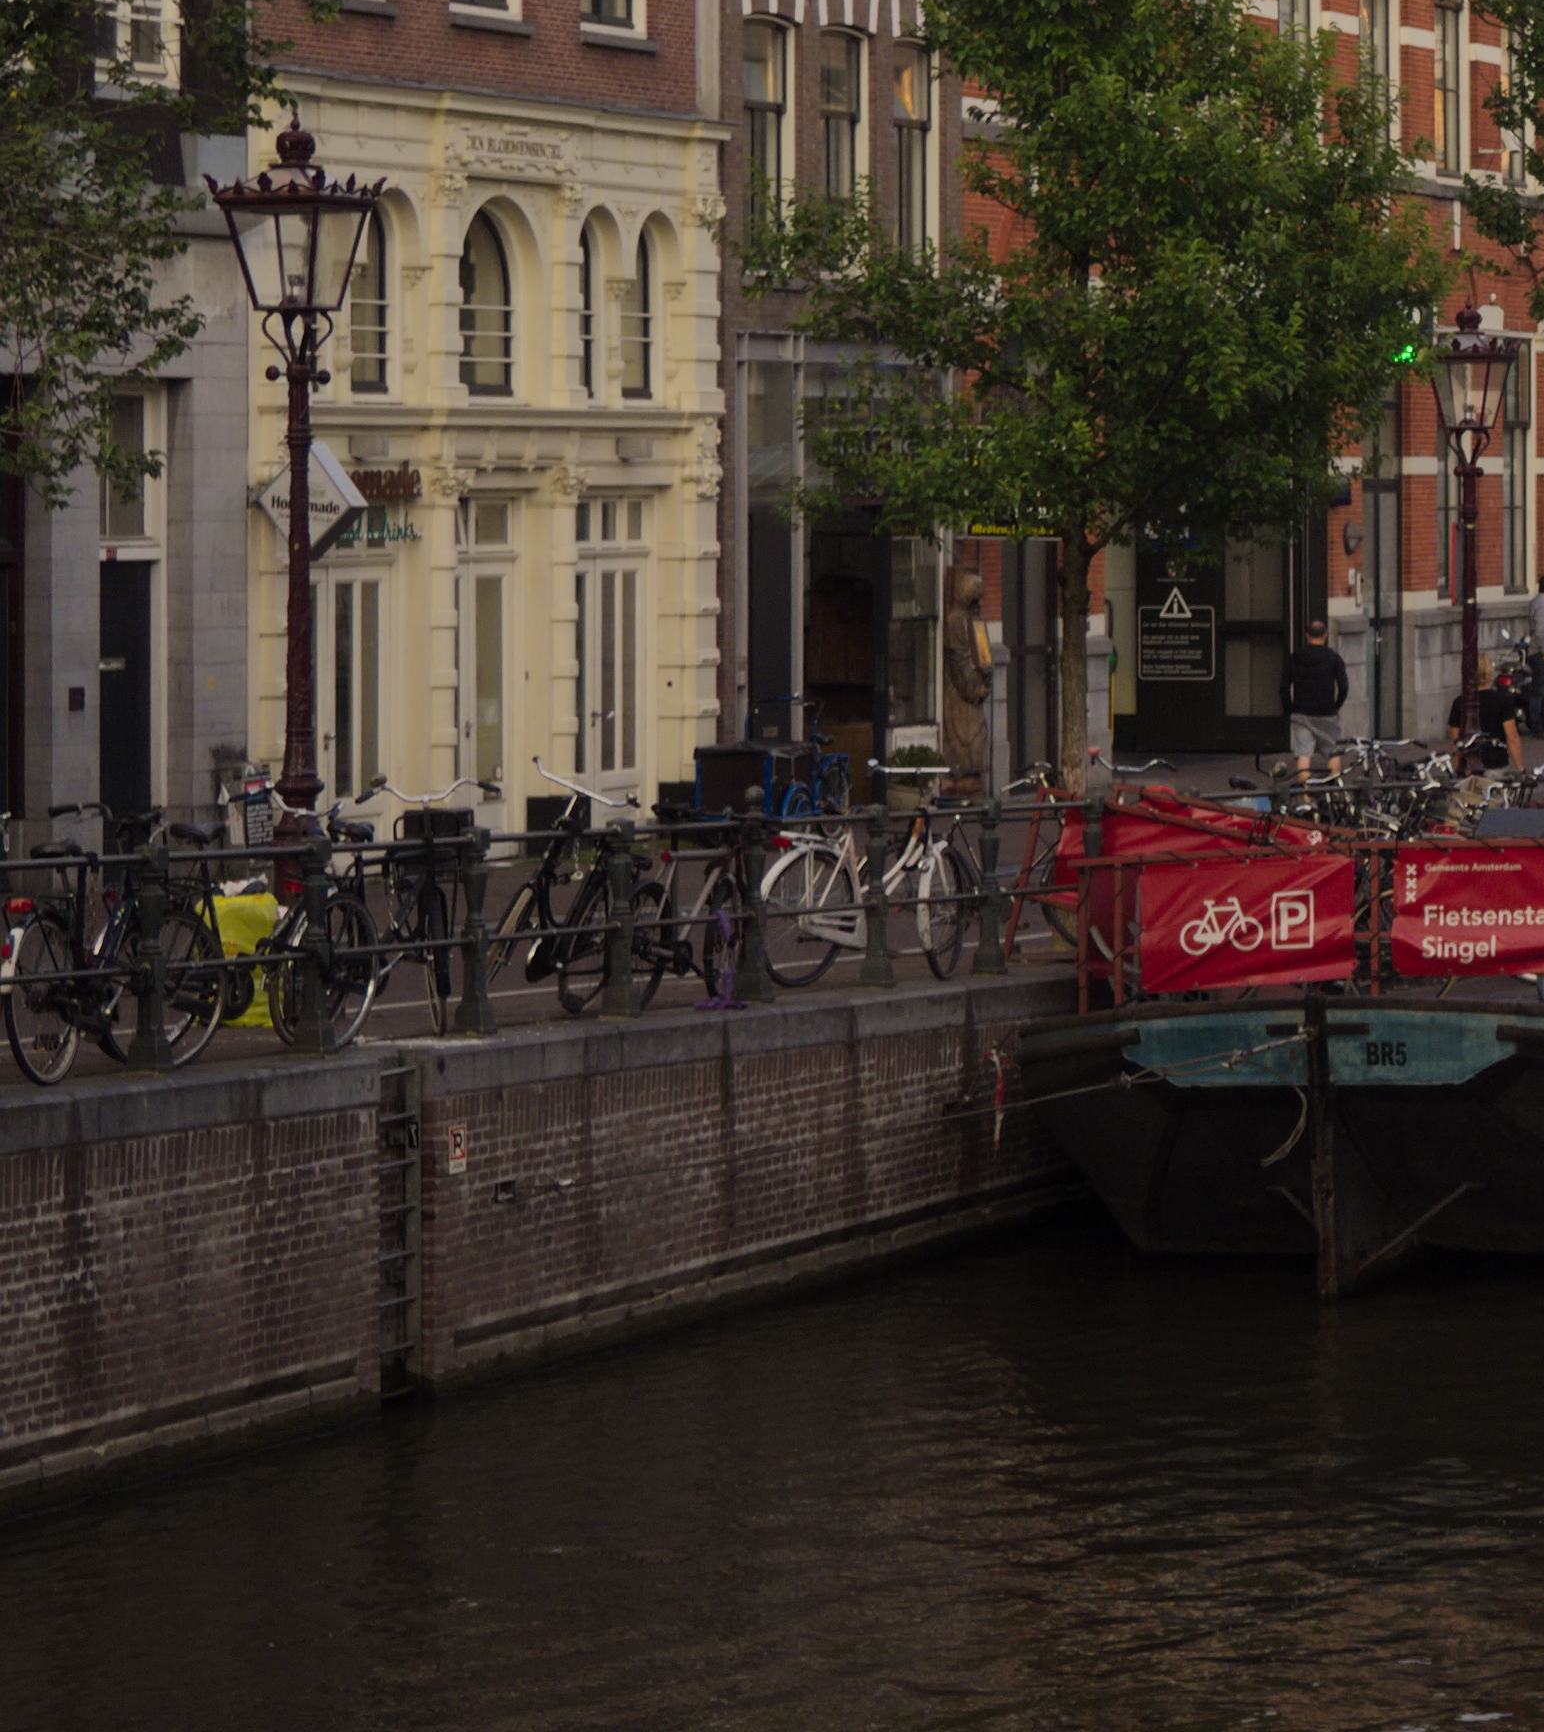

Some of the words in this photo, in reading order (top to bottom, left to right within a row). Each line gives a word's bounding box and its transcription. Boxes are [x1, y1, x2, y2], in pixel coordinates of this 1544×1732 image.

[271, 495, 340, 514] Homade
[1424, 863, 1470, 873] Gemeente
[1471, 862, 1522, 872] Amsterdam
[1279, 901, 1308, 941] P
[1421, 934, 1497, 964] Singel
